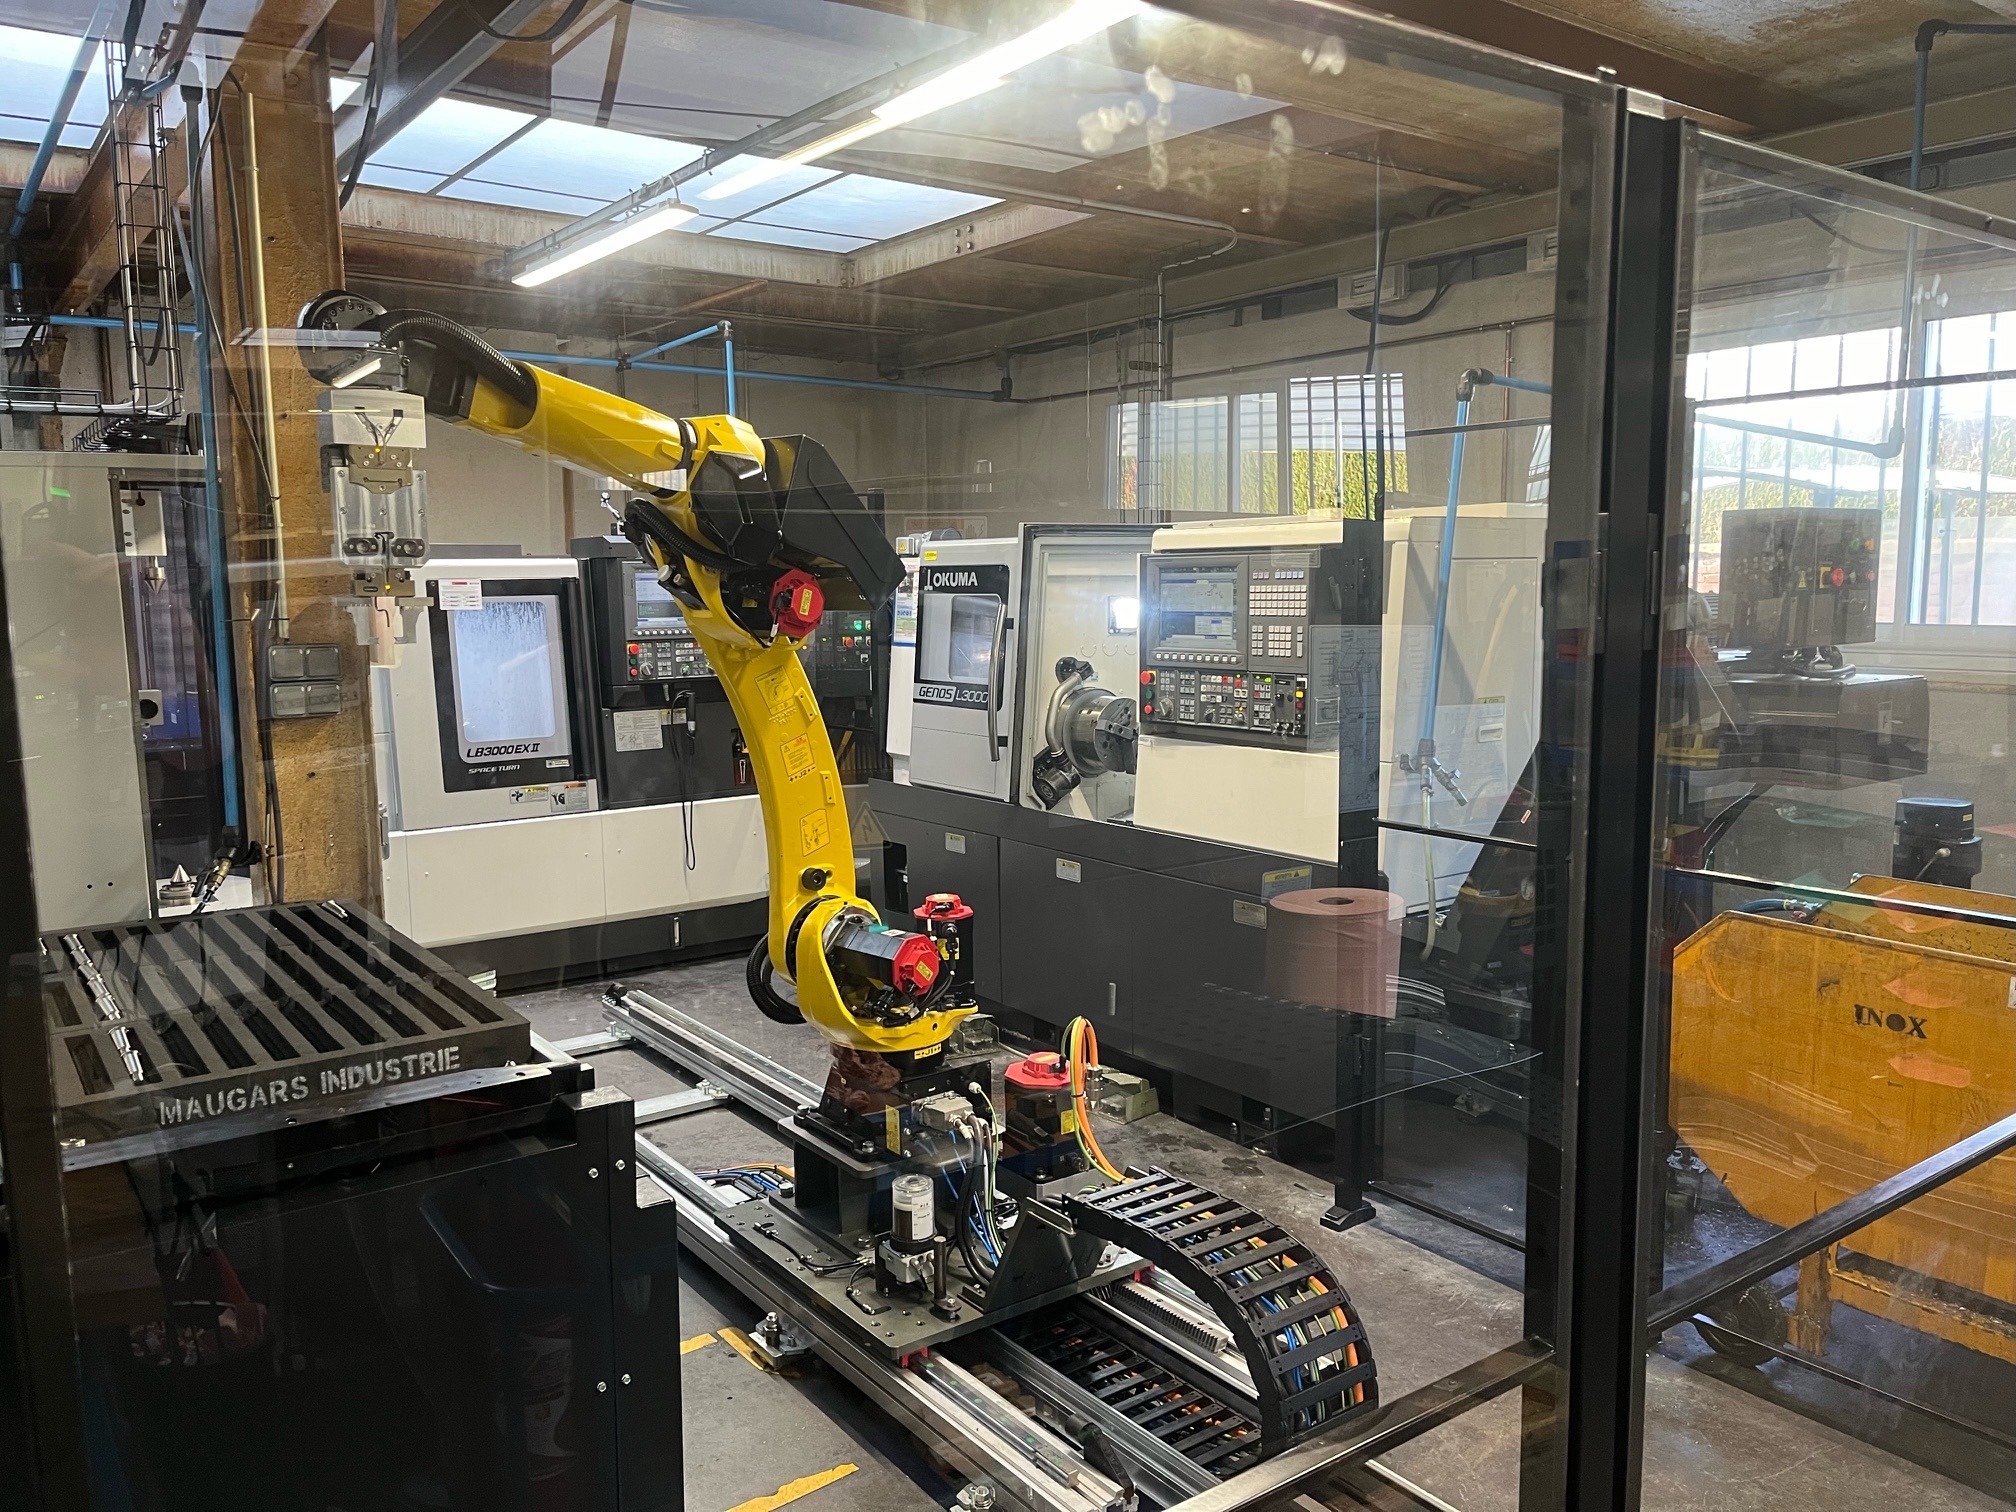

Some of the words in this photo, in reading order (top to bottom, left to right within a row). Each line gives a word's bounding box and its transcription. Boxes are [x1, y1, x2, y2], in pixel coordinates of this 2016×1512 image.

[933, 571, 978, 588] OKUMA
[917, 686, 953, 700] GENOS
[468, 767, 498, 775] SPACE
[498, 764, 520, 772] TURN
[1854, 1004, 1928, 1039] INOX
[159, 1075, 309, 1125] MAUGARS
[320, 1046, 461, 1095] INDUSTRIE
